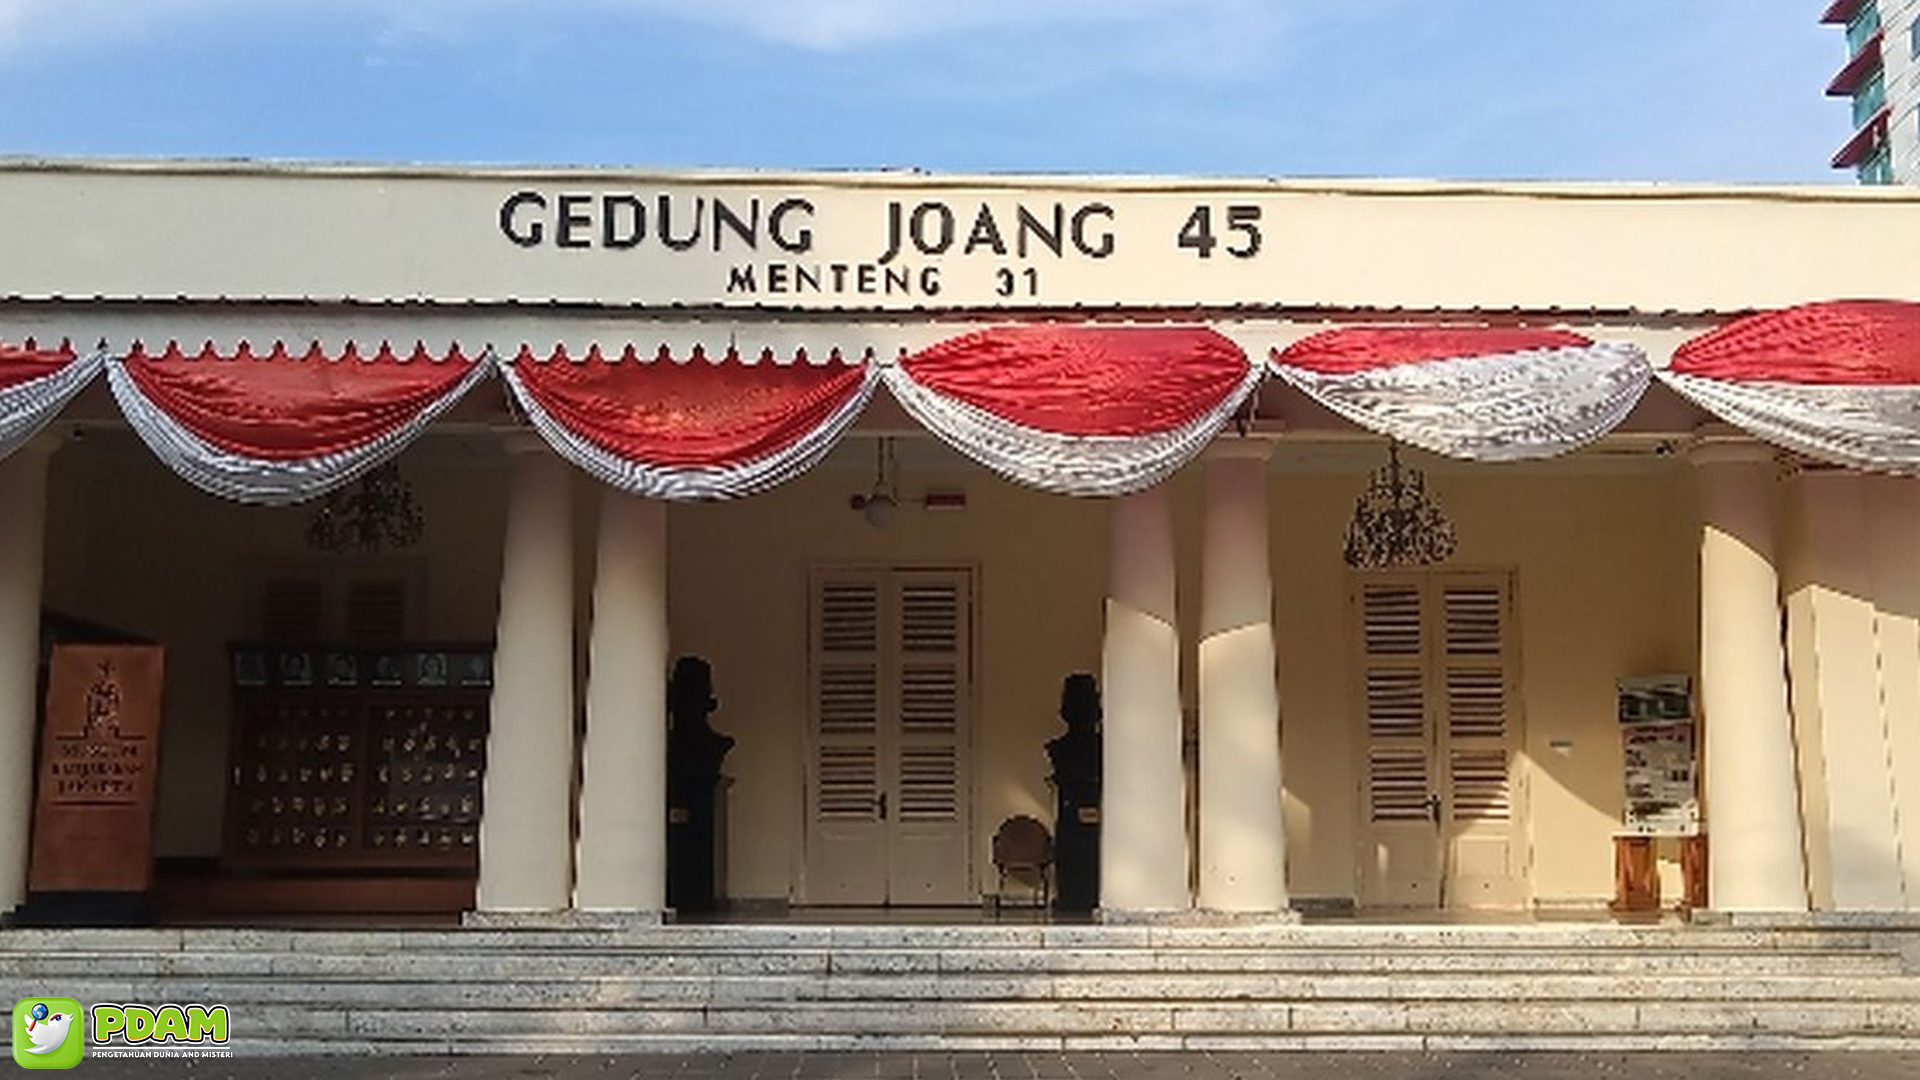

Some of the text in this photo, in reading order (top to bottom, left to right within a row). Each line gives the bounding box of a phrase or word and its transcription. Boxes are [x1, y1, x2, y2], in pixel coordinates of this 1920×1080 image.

[499, 191, 1262, 265] GEDUNG JOANG 45
[726, 264, 1038, 297] MENTENG 31
